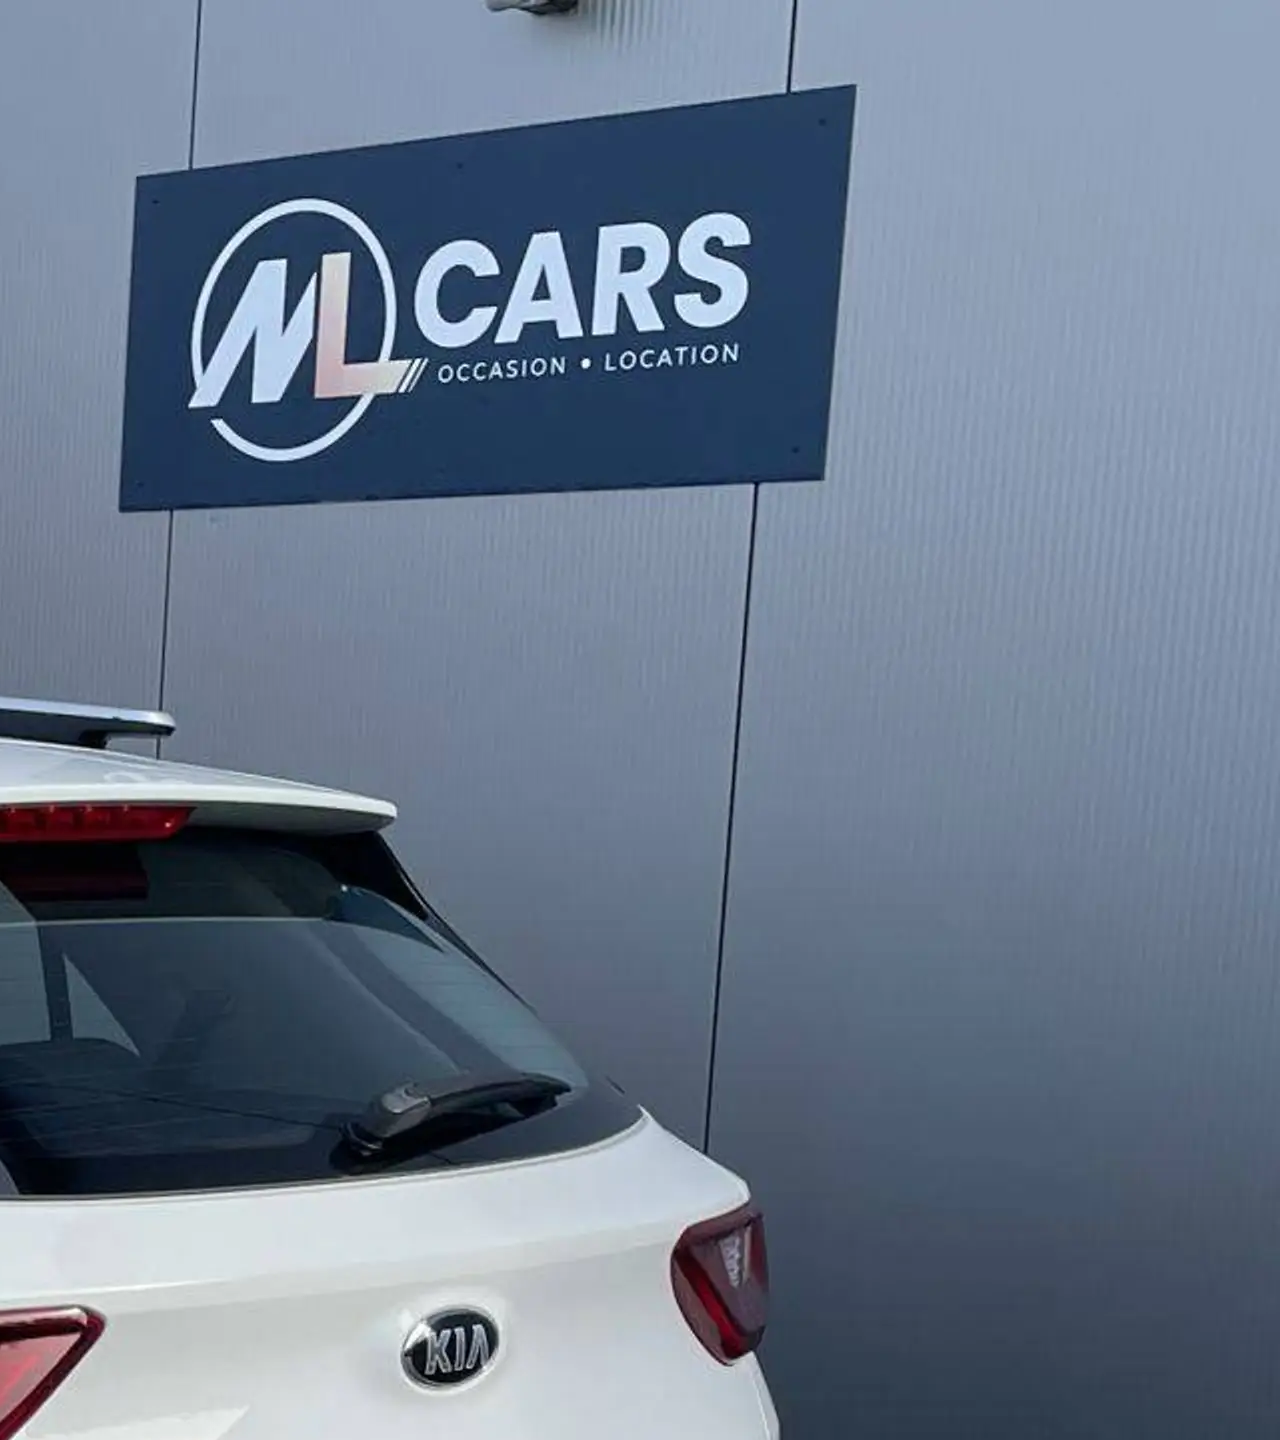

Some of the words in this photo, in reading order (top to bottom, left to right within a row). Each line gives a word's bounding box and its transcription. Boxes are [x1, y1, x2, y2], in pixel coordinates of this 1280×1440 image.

[187, 251, 425, 409] ML
[414, 211, 751, 348] CARS
[438, 356, 566, 383] OCCASION
[604, 344, 740, 371] LOCATION
[424, 1324, 490, 1375] KIA
